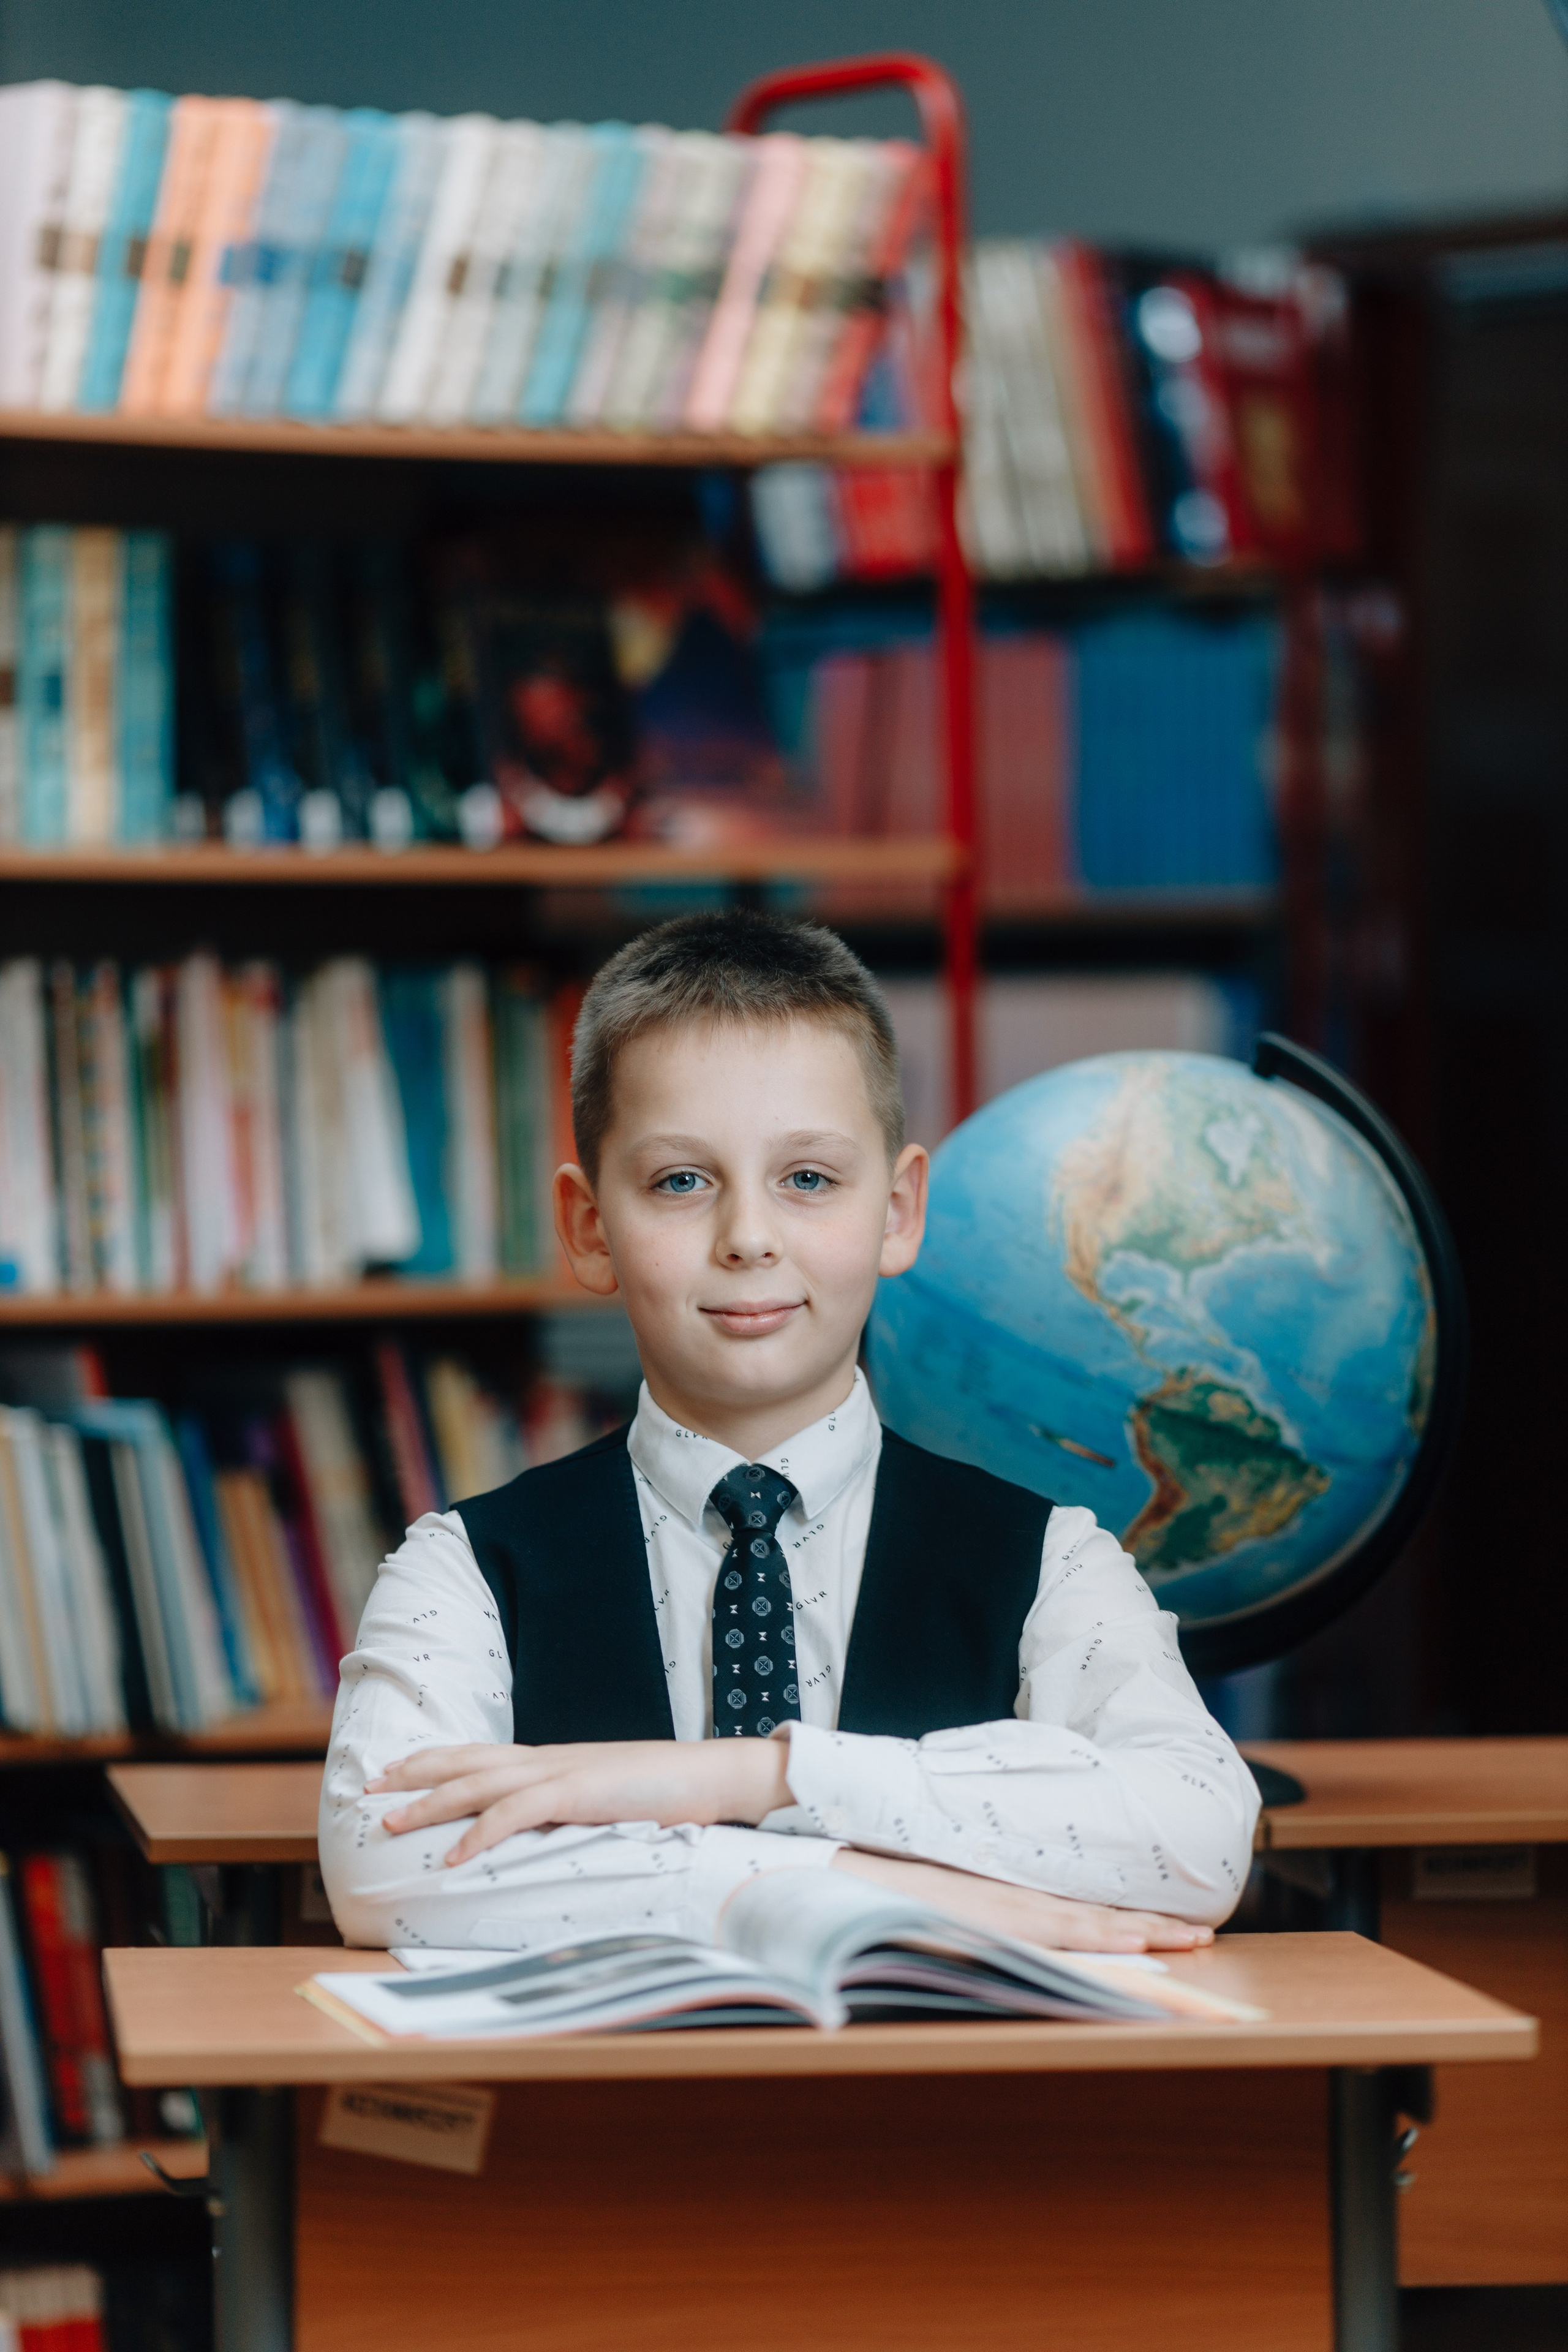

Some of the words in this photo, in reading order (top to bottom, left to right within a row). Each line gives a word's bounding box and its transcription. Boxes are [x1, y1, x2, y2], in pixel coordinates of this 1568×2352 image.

[793, 1523, 824, 1548] GLVR
[795, 1590, 827, 1611] GLVR
[489, 1649, 502, 1659] GL
[1079, 1638, 1102, 1670] GLVR
[805, 1664, 832, 1688] GLVR
[1152, 1844, 1169, 1881] GLVR
